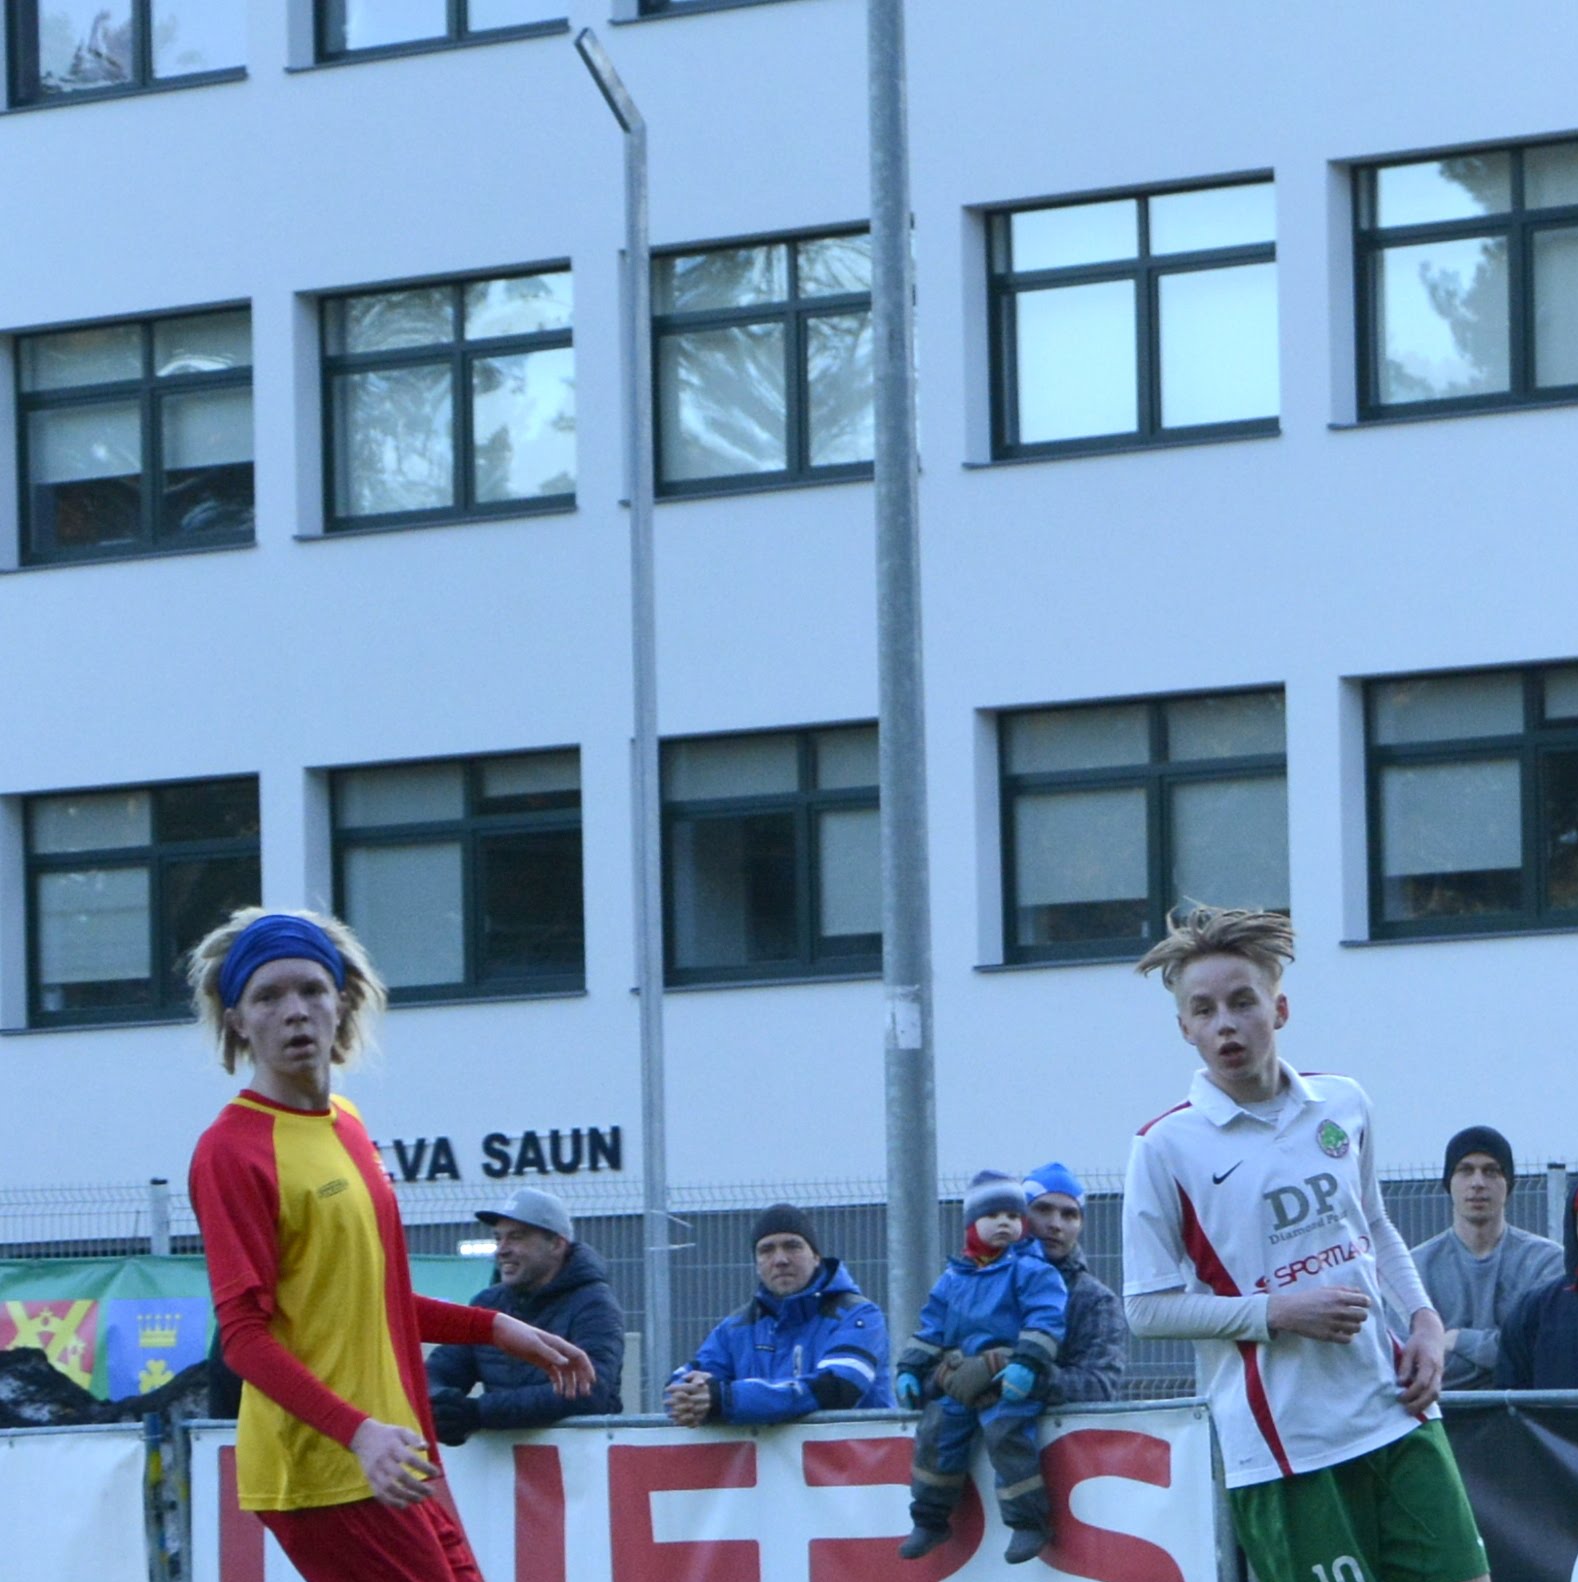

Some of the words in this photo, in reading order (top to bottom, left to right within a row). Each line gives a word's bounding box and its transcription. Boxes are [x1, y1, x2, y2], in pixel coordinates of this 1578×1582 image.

[373, 1136, 461, 1183] VA
[482, 1126, 622, 1179] SAUN
[1263, 1172, 1338, 1232] DP
